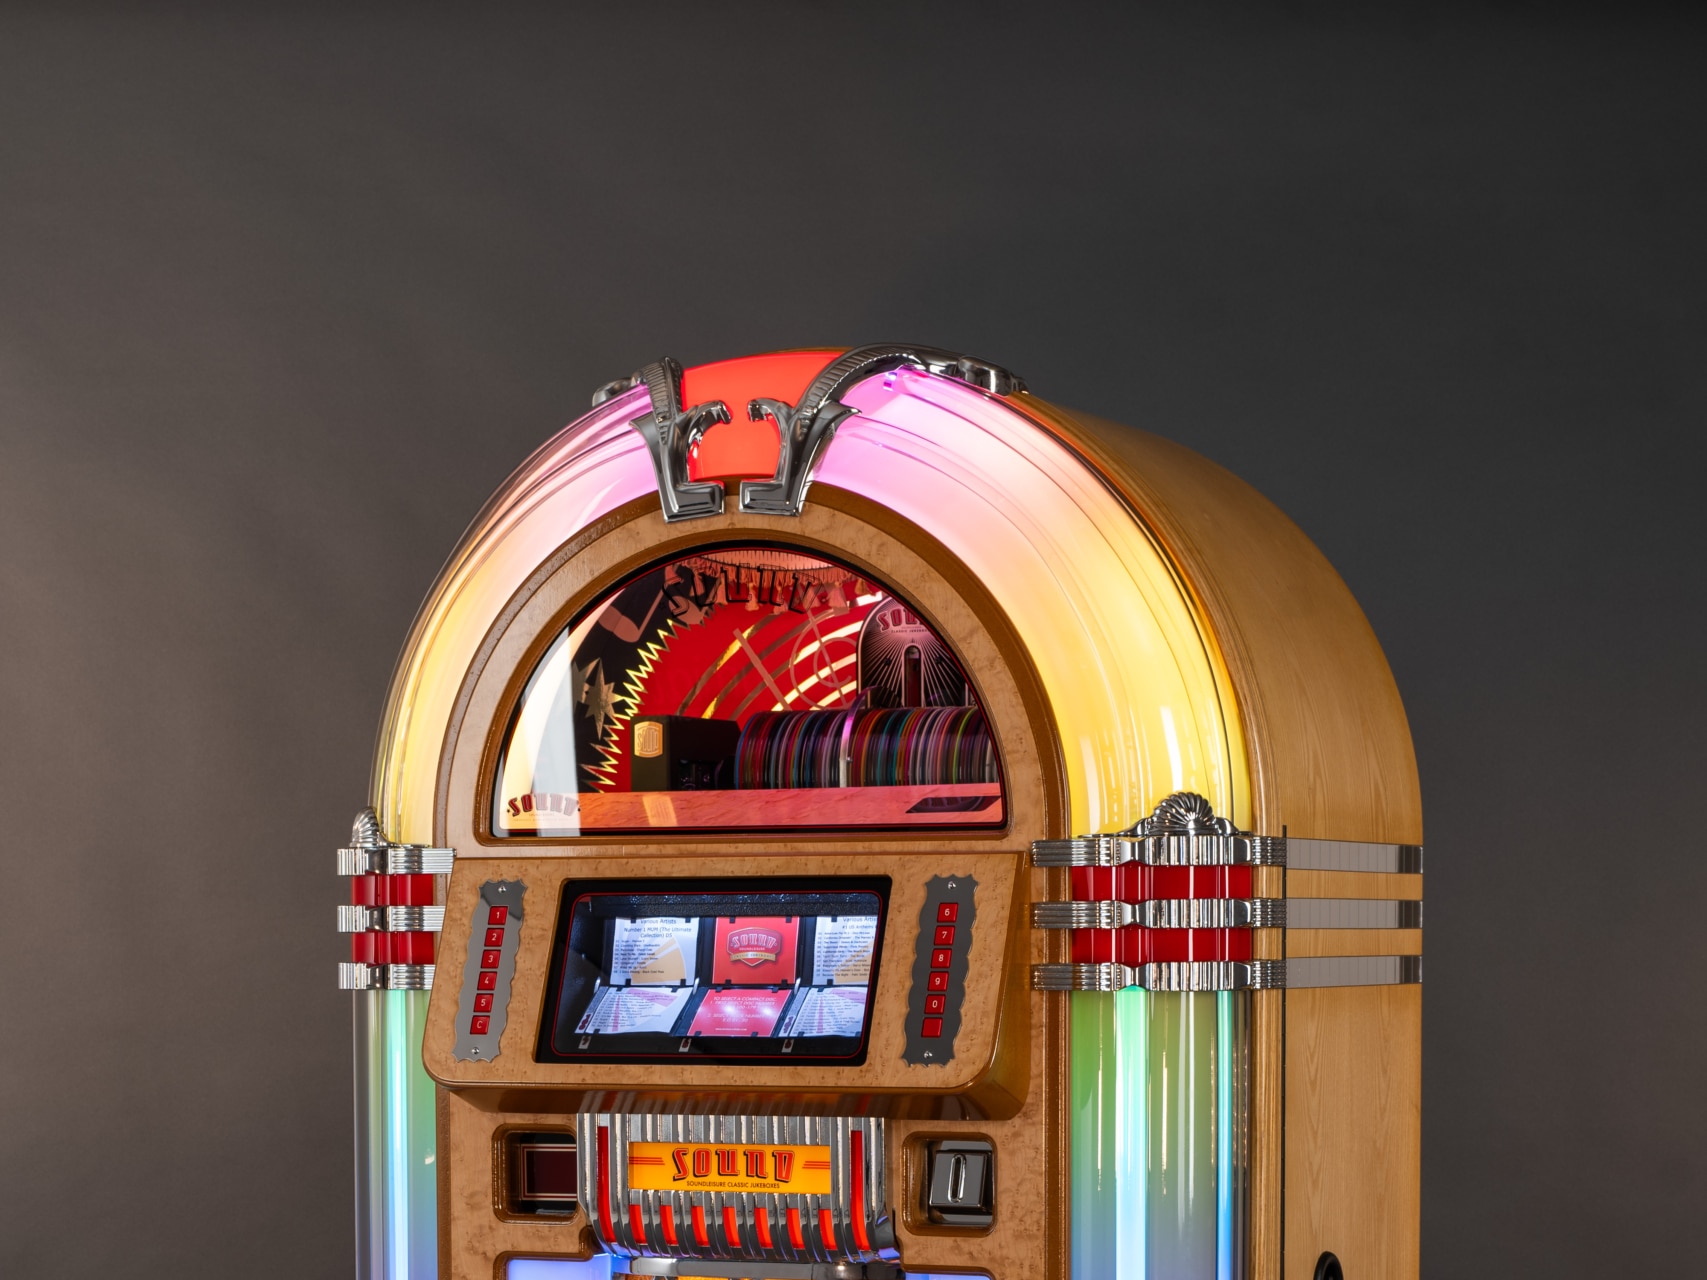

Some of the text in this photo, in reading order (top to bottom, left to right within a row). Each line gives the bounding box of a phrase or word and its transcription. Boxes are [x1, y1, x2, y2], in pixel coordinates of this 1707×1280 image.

[876, 607, 924, 631] SOU
[507, 793, 579, 817] SOUND
[944, 908, 949, 916] 6
[492, 933, 497, 941] 2
[942, 931, 947, 939] 7
[732, 933, 776, 948] SOUND
[488, 955, 493, 963] 3
[932, 1000, 938, 1008] 0
[672, 1148, 795, 1183] SOUND
[686, 1180, 726, 1188] SOUNDLEISURE
